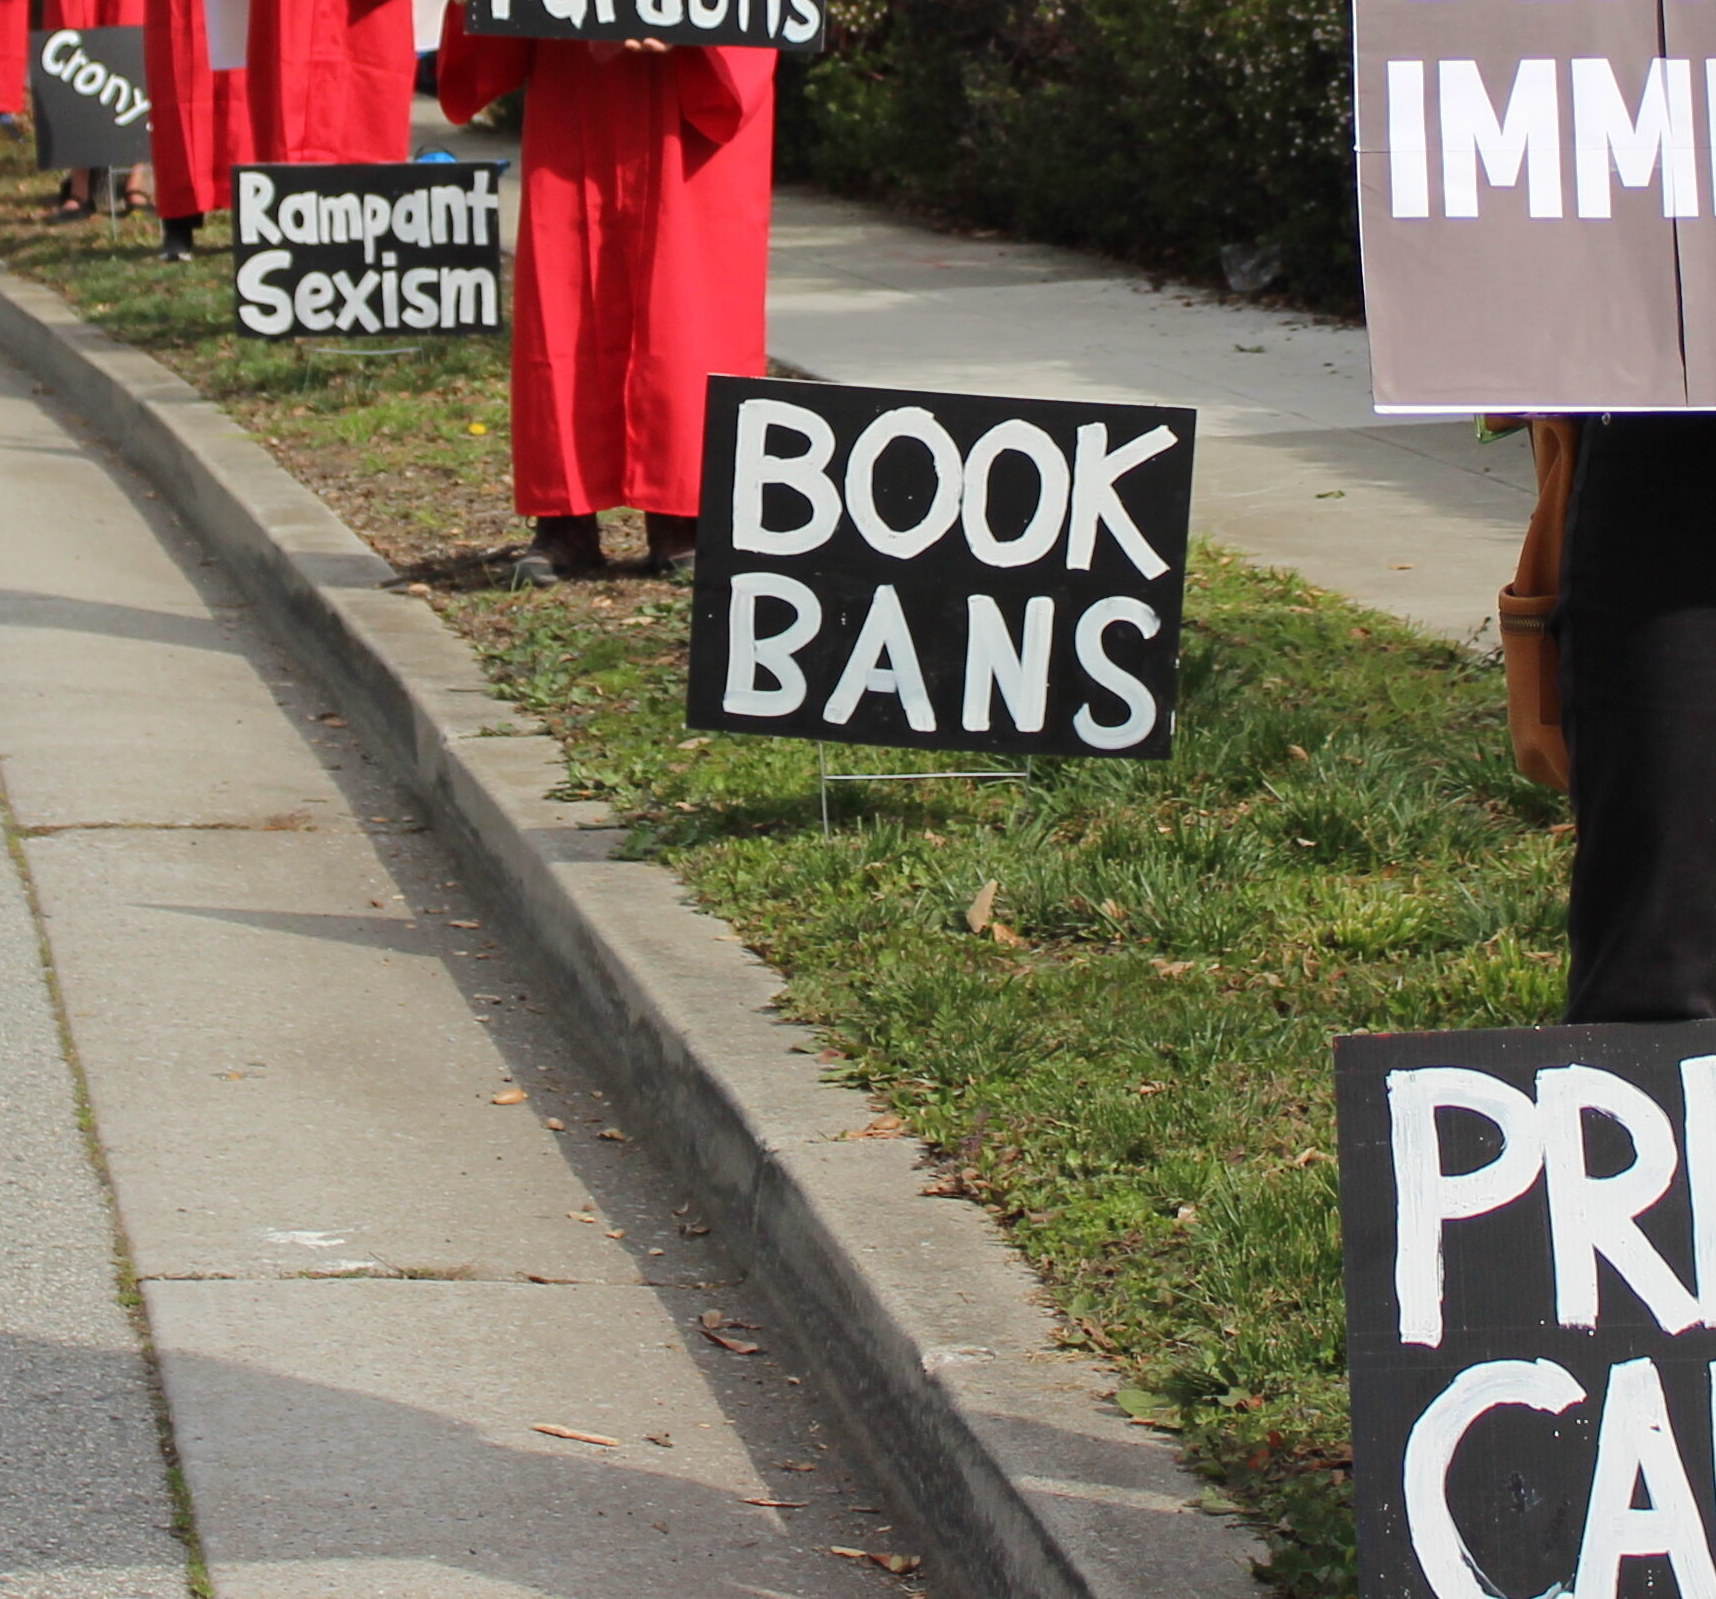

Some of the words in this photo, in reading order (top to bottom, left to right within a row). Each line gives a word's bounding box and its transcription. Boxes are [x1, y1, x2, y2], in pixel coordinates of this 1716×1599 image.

[42, 28, 152, 127] Crony
[238, 170, 498, 264] Rampant
[236, 249, 497, 335] Sexism
[732, 398, 1178, 581] BOOK
[722, 572, 1161, 751] BANS
